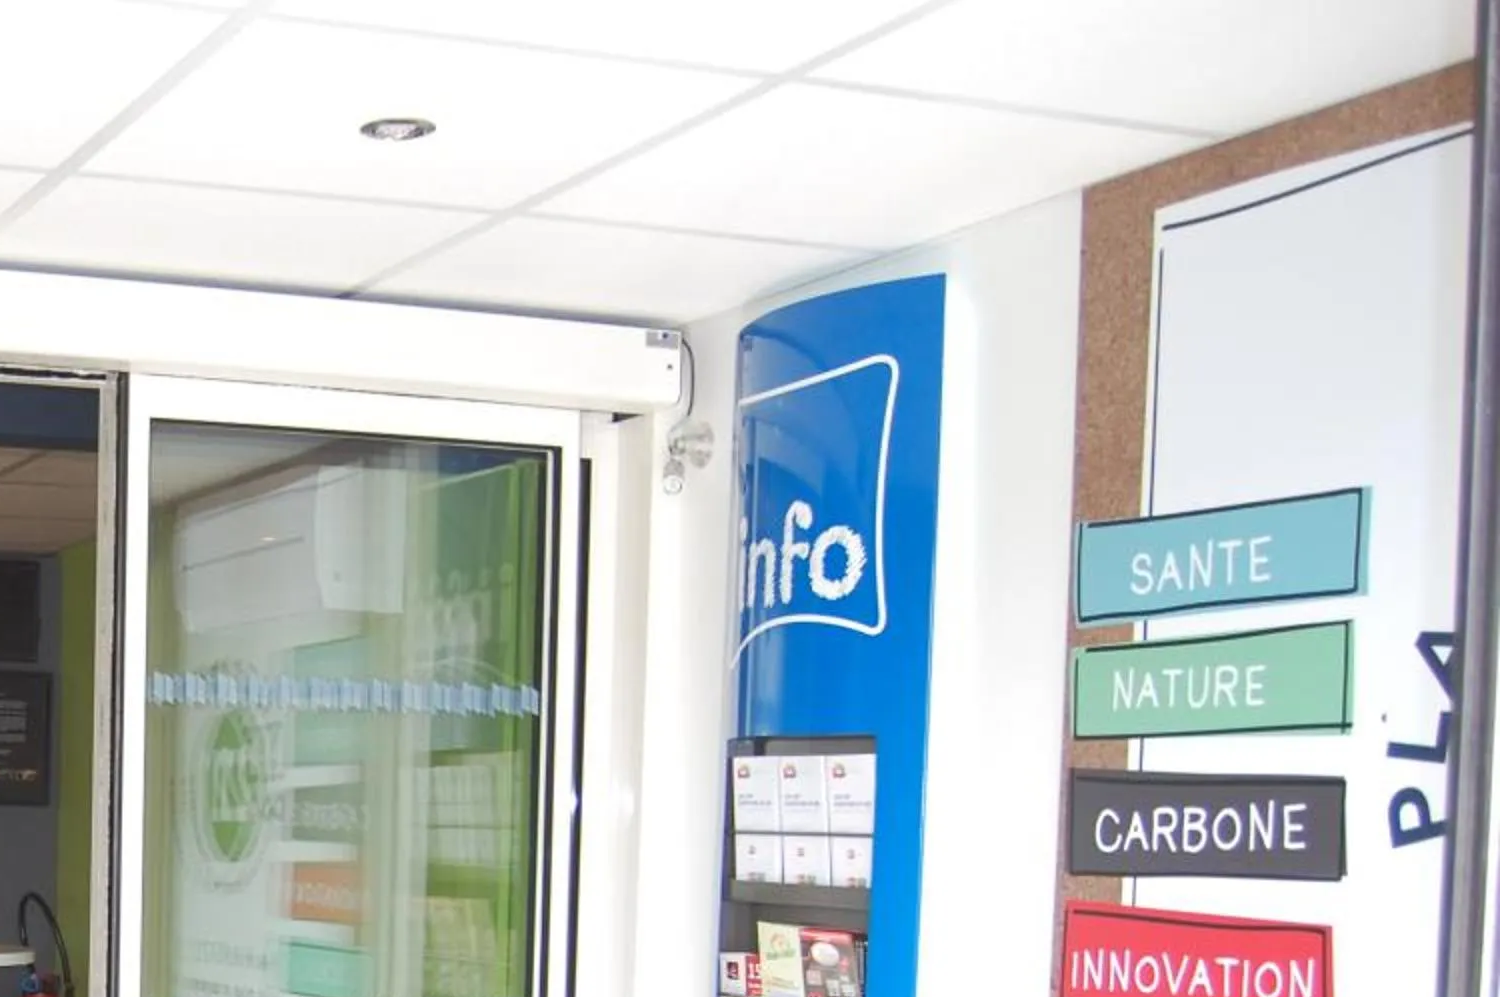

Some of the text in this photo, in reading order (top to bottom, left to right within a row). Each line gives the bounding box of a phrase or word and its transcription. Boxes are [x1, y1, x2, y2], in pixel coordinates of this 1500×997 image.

[738, 499, 867, 612] info
[1130, 535, 1273, 595] SANTE
[1111, 665, 1267, 712] NATURE
[1094, 800, 1307, 854] CARBONE
